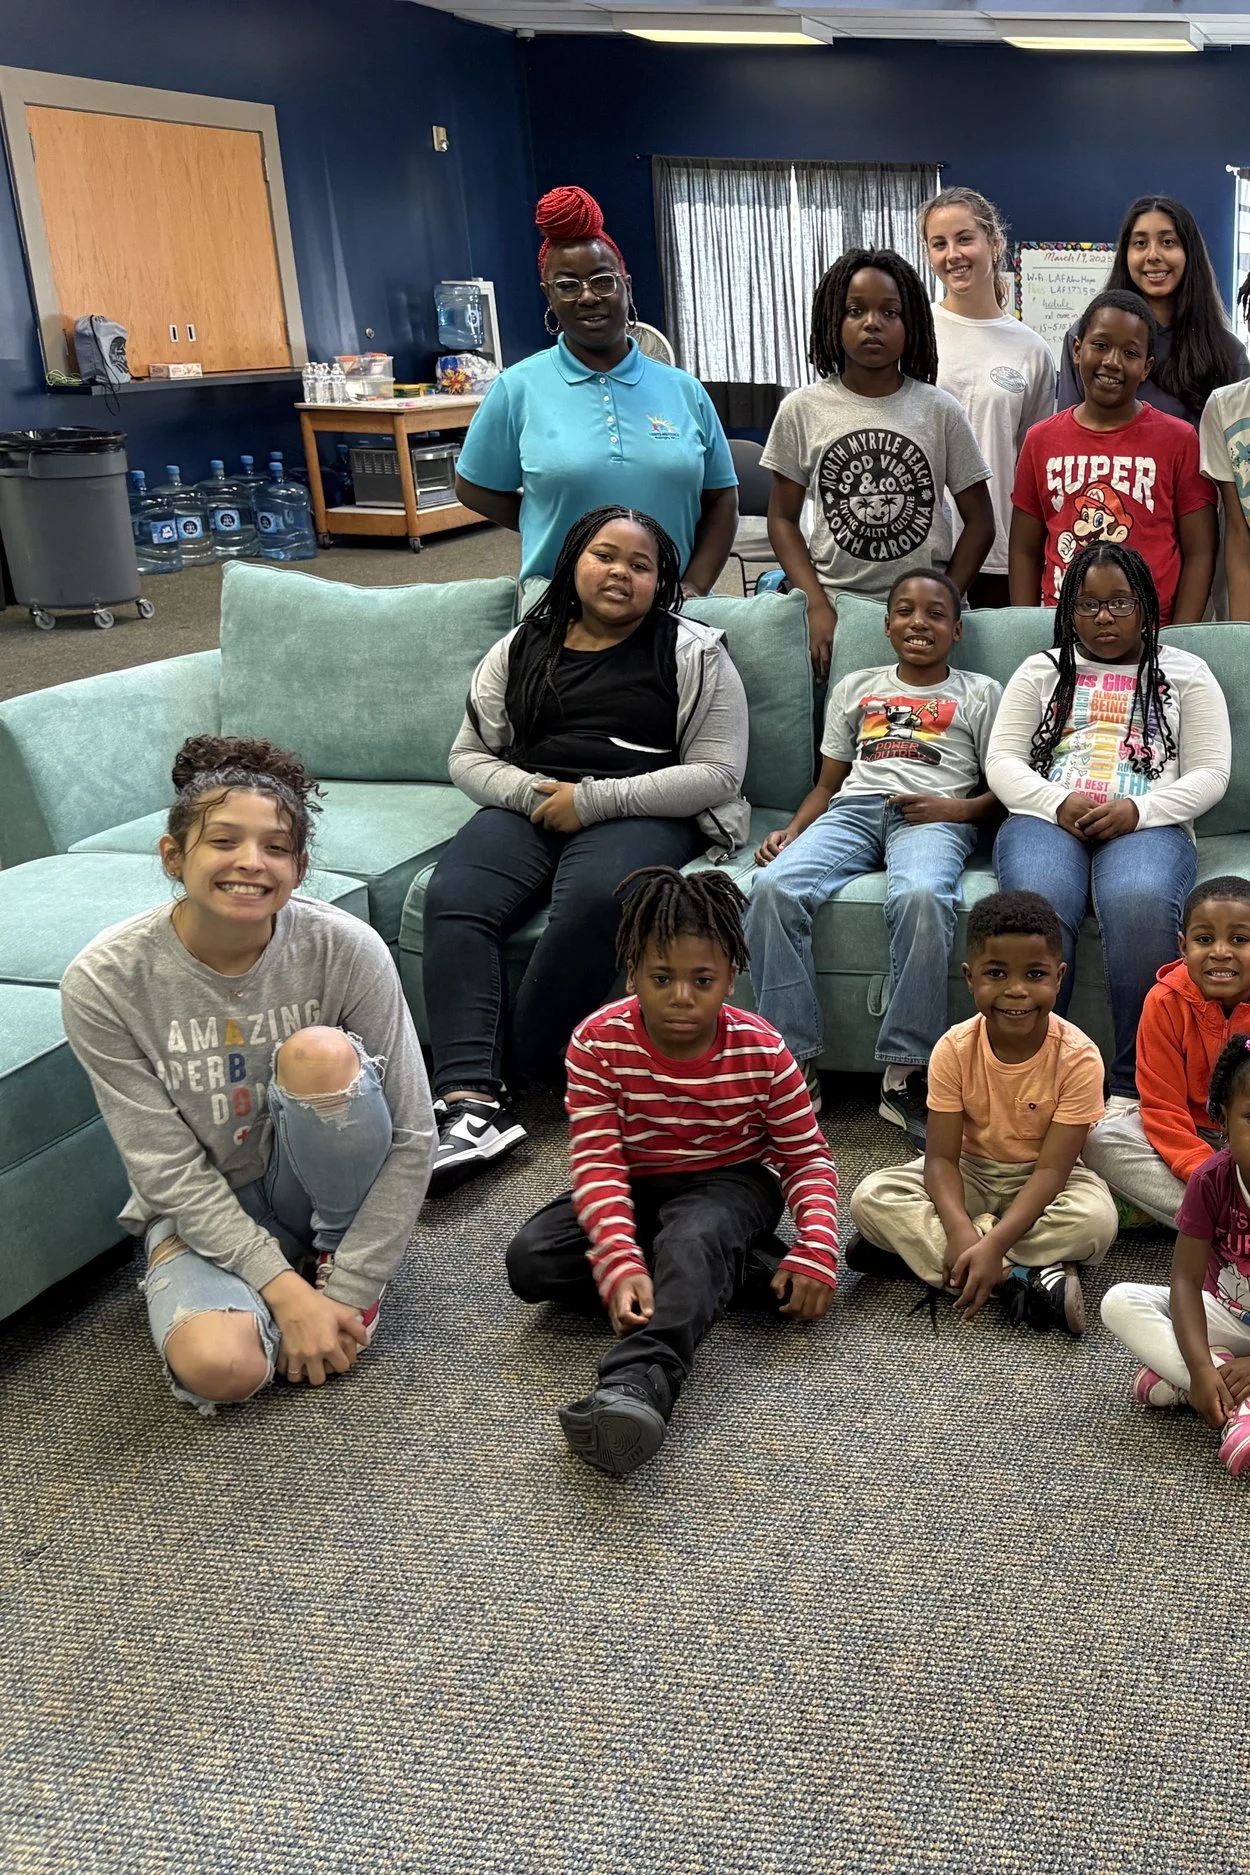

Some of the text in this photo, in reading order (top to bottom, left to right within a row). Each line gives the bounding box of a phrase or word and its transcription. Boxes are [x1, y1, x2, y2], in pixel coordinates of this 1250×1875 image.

[1044, 252, 1075, 263] March
[822, 432, 931, 489] NORTH MYRTLE BEACH
[839, 455, 915, 494] GOOD VIBES
[859, 472, 878, 494] &
[1046, 455, 1156, 513] SUPER
[840, 496, 915, 538] LIVING SALTY CULTURE
[826, 507, 931, 559] SOUTH CAROLINA
[1091, 698, 1127, 715] BEING
[1092, 690, 1129, 701] ALWAYS
[875, 741, 920, 752] POWER
[1085, 779, 1111, 792] BEST
[167, 999, 321, 1053] AMAZING
